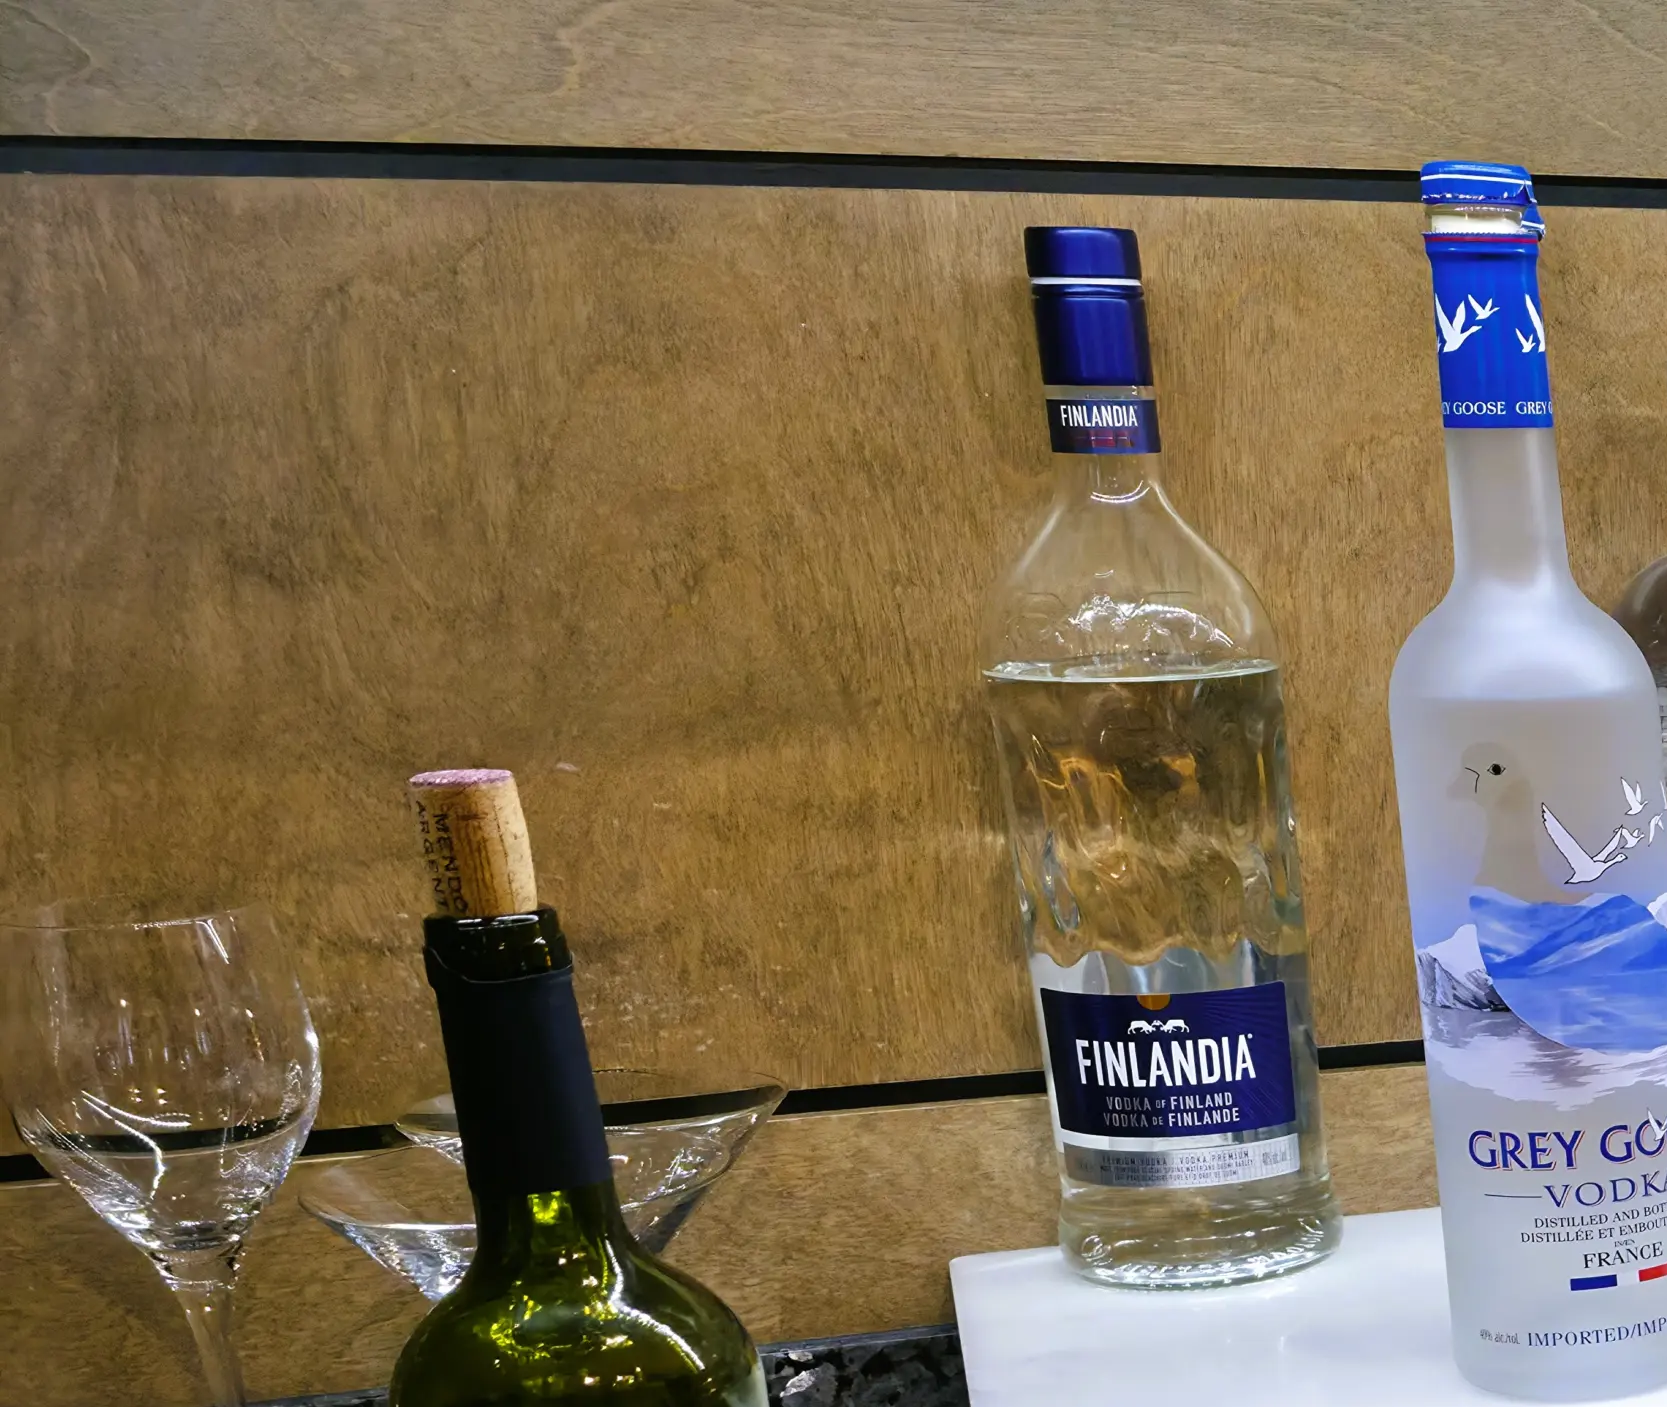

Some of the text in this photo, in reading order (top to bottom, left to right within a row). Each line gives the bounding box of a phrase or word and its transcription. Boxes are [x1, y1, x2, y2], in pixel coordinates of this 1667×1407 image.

[1060, 405, 1138, 427] FINLANDIA
[1453, 401, 1547, 415] GOOSE GREY
[1075, 1034, 1257, 1088] FINLANDIA
[1106, 1092, 1233, 1111] VODKA OF FINLAND
[1103, 1107, 1240, 1128] VODKA DE FINLANDE
[1469, 1130, 1586, 1171] GREY
[1534, 1213, 1608, 1230] DISTILLED
[1612, 1209, 1640, 1224] AND
[1520, 1228, 1594, 1244] DISTILLÉE
[1598, 1227, 1615, 1240] ET
[1583, 1241, 1664, 1269] FRANCE
